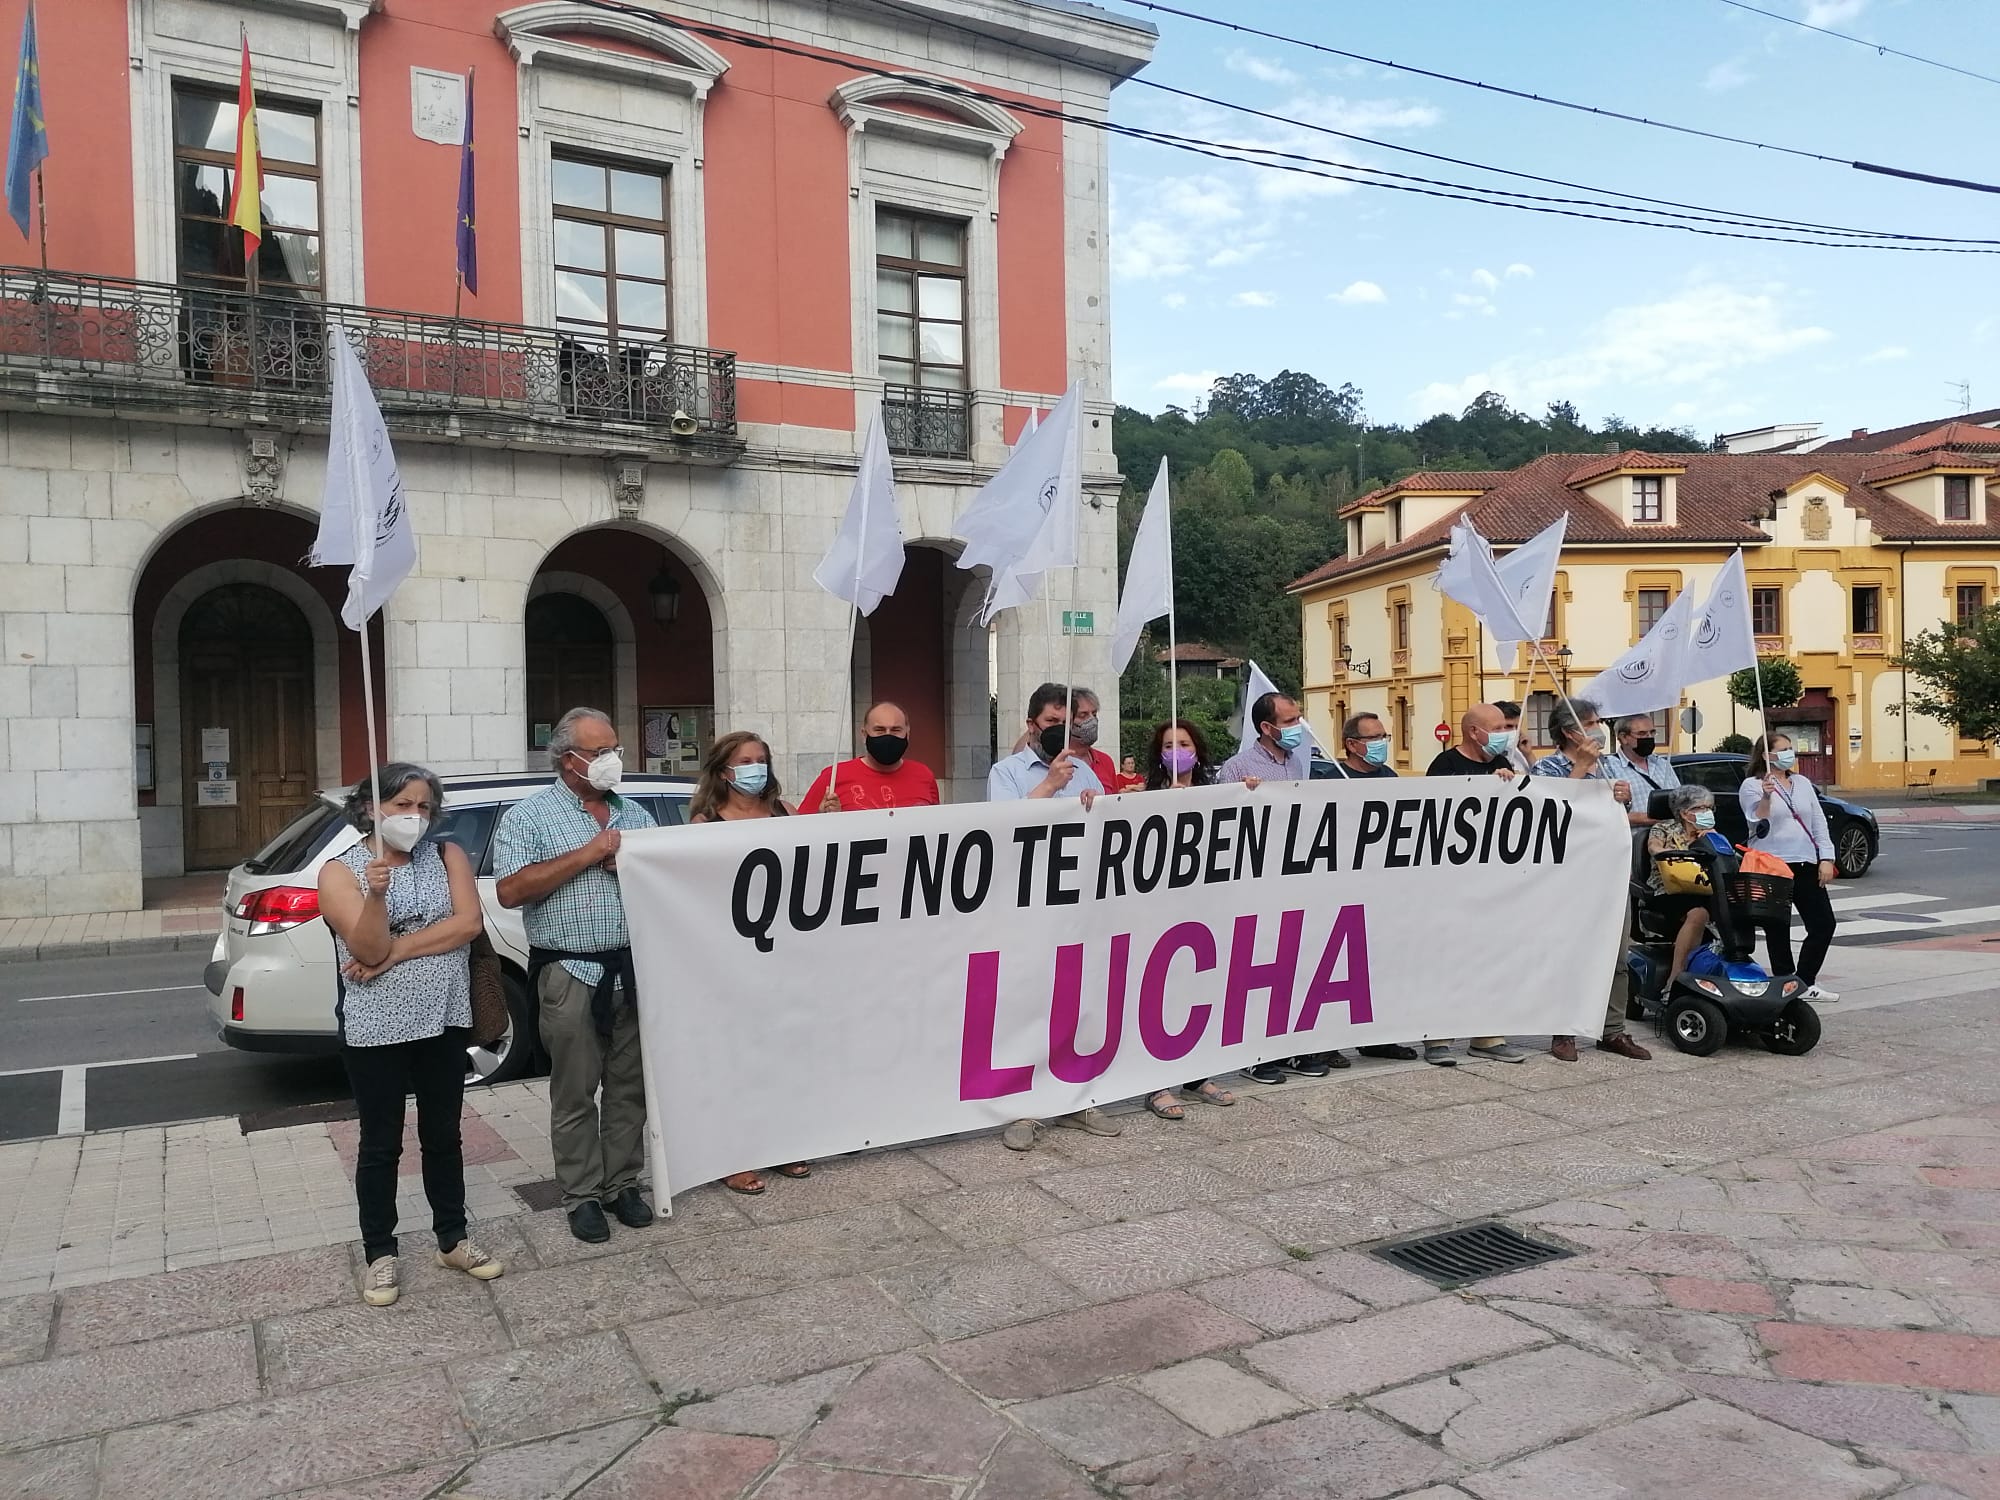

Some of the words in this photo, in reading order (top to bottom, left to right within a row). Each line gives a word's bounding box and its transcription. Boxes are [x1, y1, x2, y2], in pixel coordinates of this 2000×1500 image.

[732, 839, 888, 953] QUE
[901, 830, 994, 920] NO
[1013, 823, 1086, 908] TE
[1096, 805, 1272, 901] ROBEN
[1281, 801, 1338, 876] LA
[1352, 775, 1573, 871] PENSIÓN
[959, 904, 1373, 1102] LUCHA
